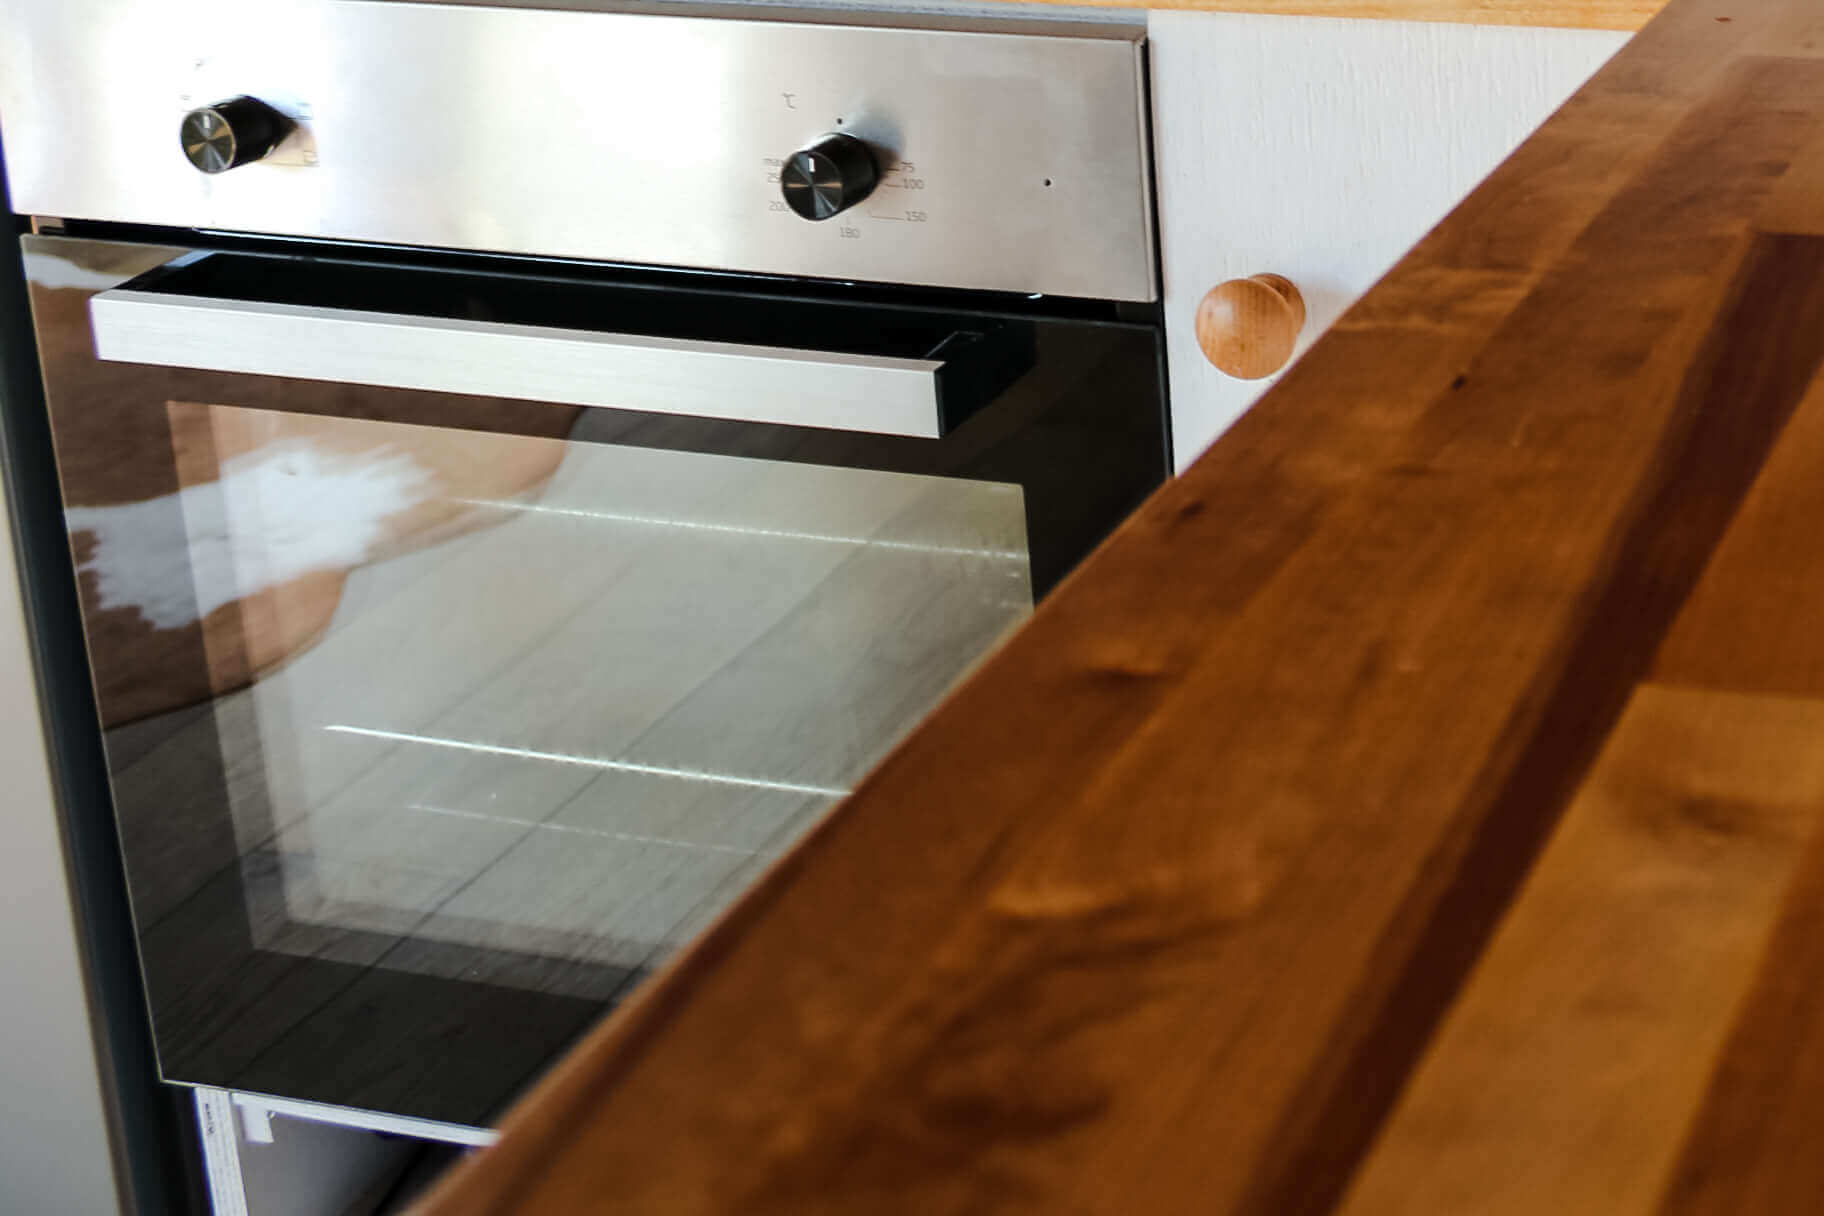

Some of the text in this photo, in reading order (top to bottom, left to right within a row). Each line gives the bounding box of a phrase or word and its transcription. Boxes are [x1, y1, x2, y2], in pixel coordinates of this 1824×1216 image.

[903, 177, 925, 190] 100
[904, 210, 928, 222] 150
[839, 226, 861, 239] 180
